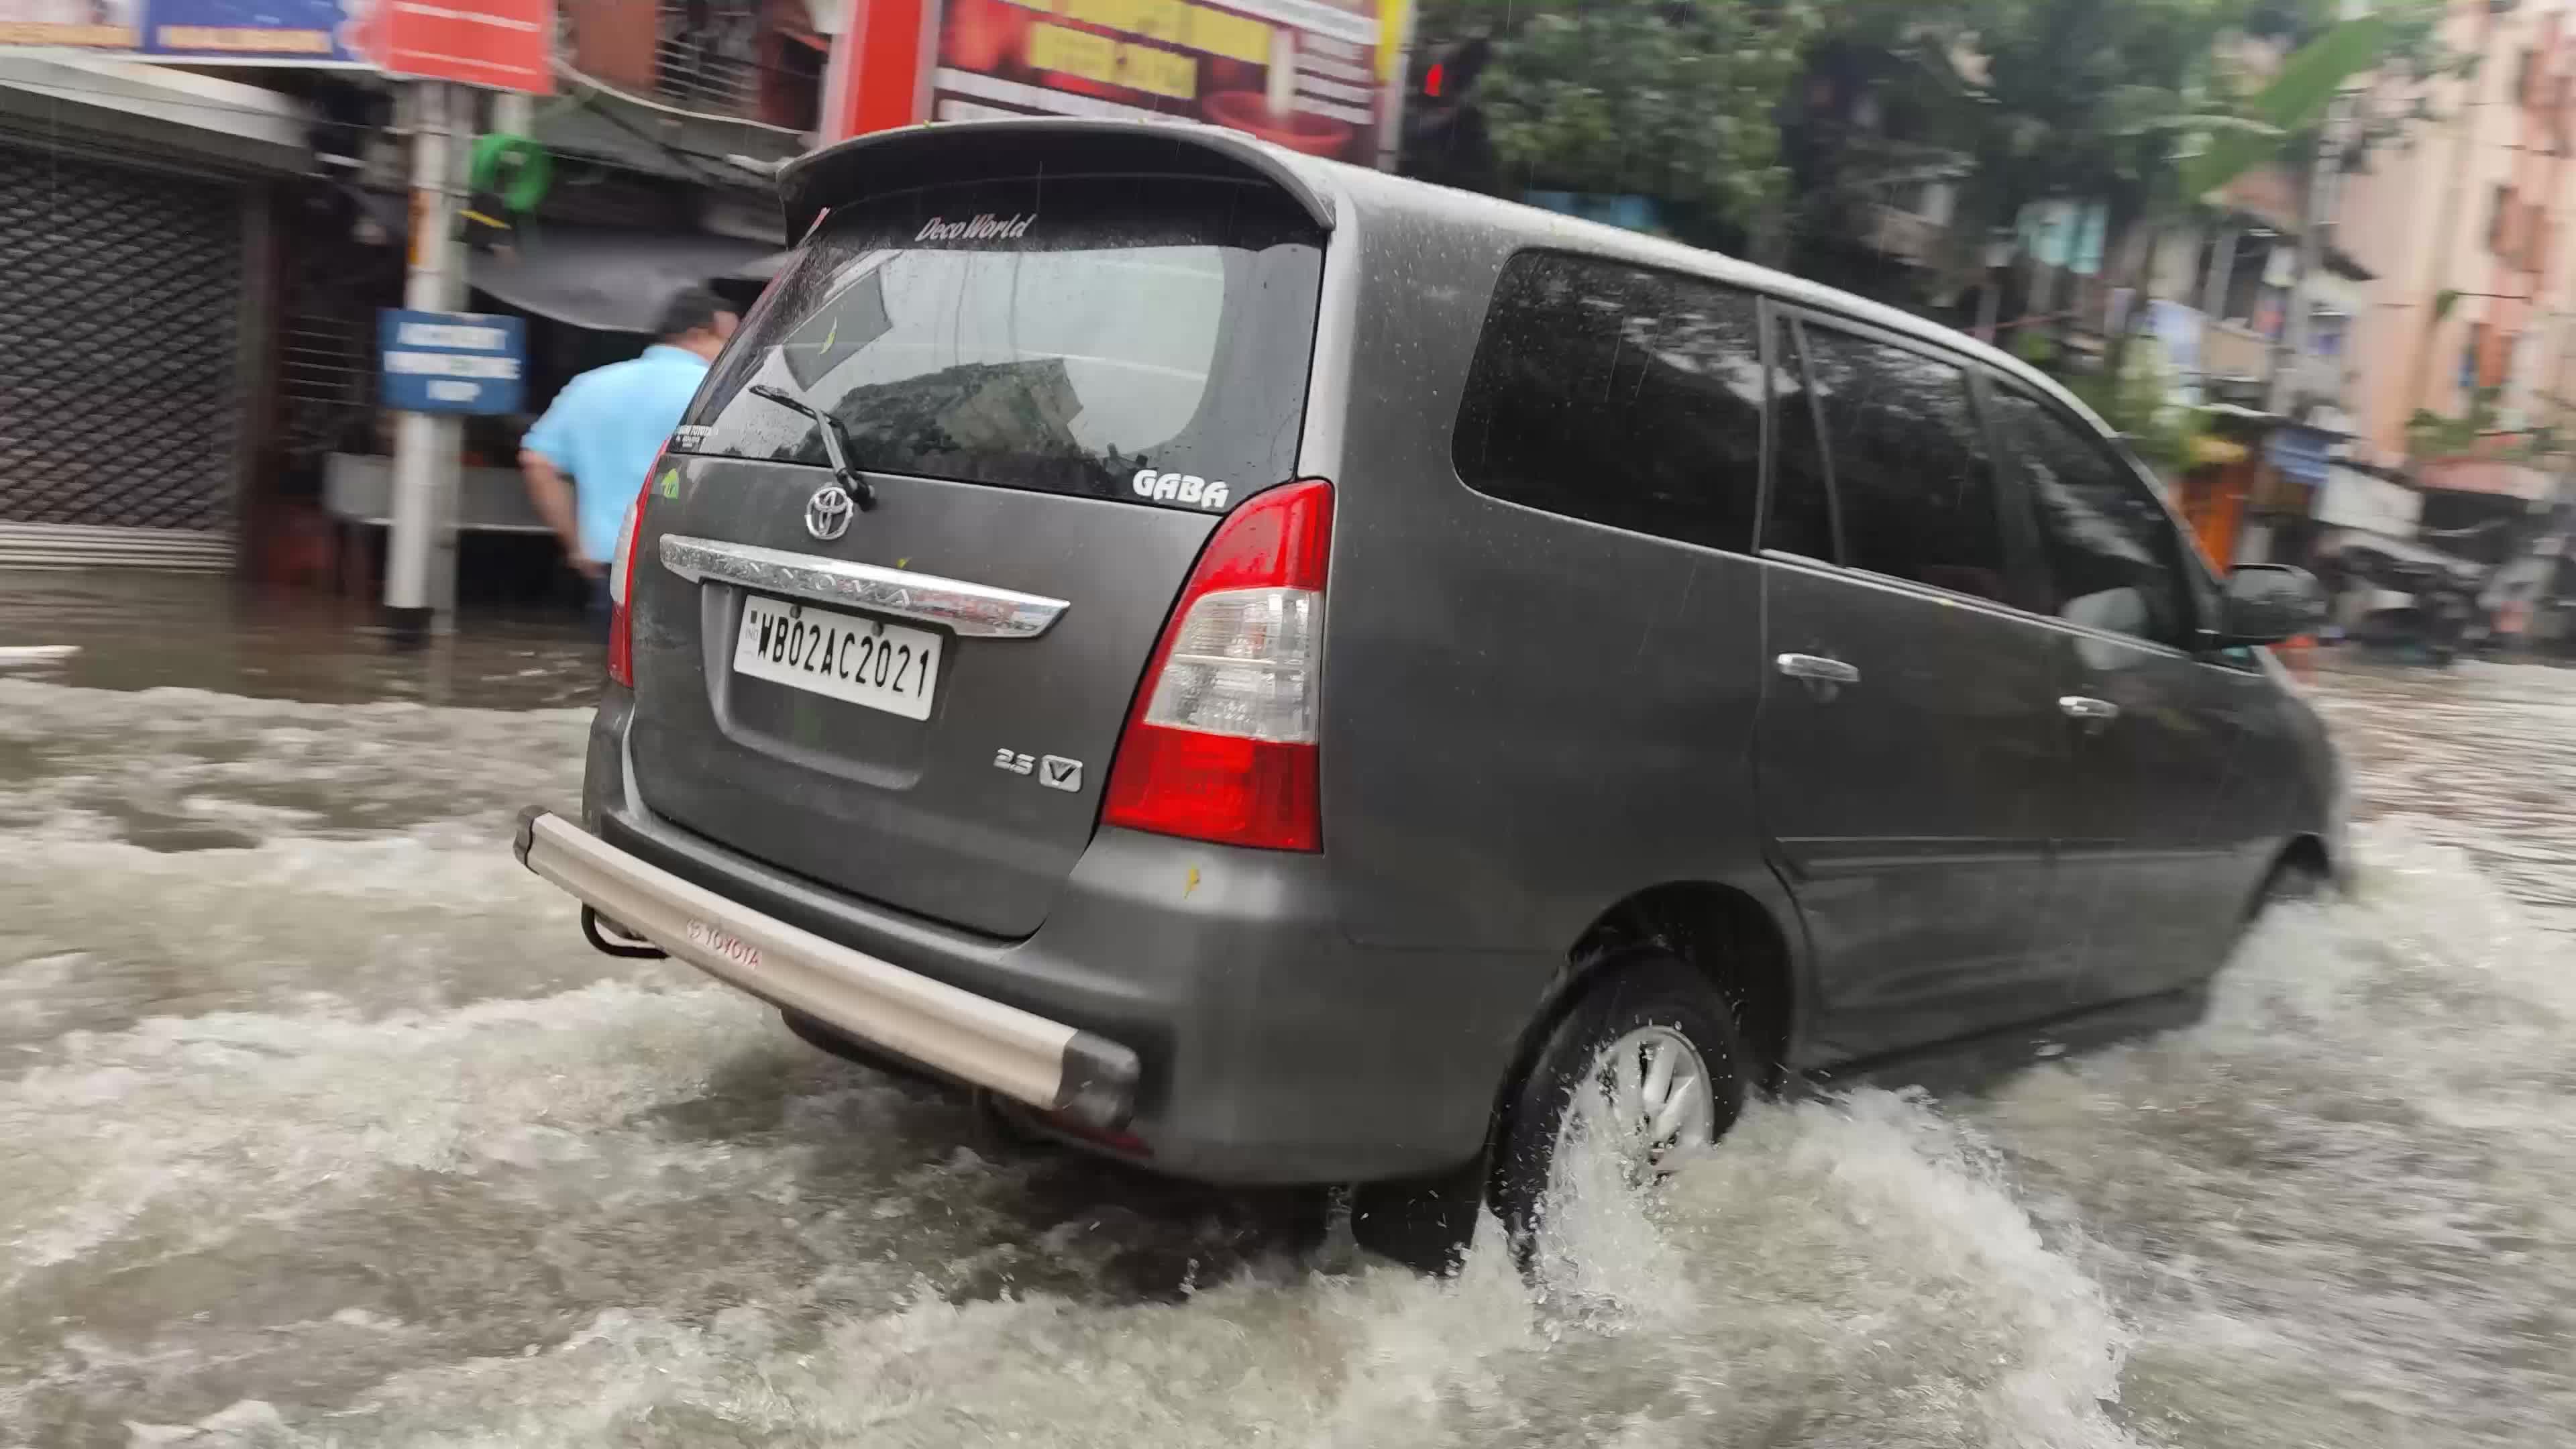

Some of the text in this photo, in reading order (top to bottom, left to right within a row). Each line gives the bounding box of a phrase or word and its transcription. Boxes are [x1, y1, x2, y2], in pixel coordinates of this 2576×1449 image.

[1132, 470, 1230, 508] GABA
[757, 612, 929, 698] WB02AC2021
[704, 926, 761, 967] TOYOTA
